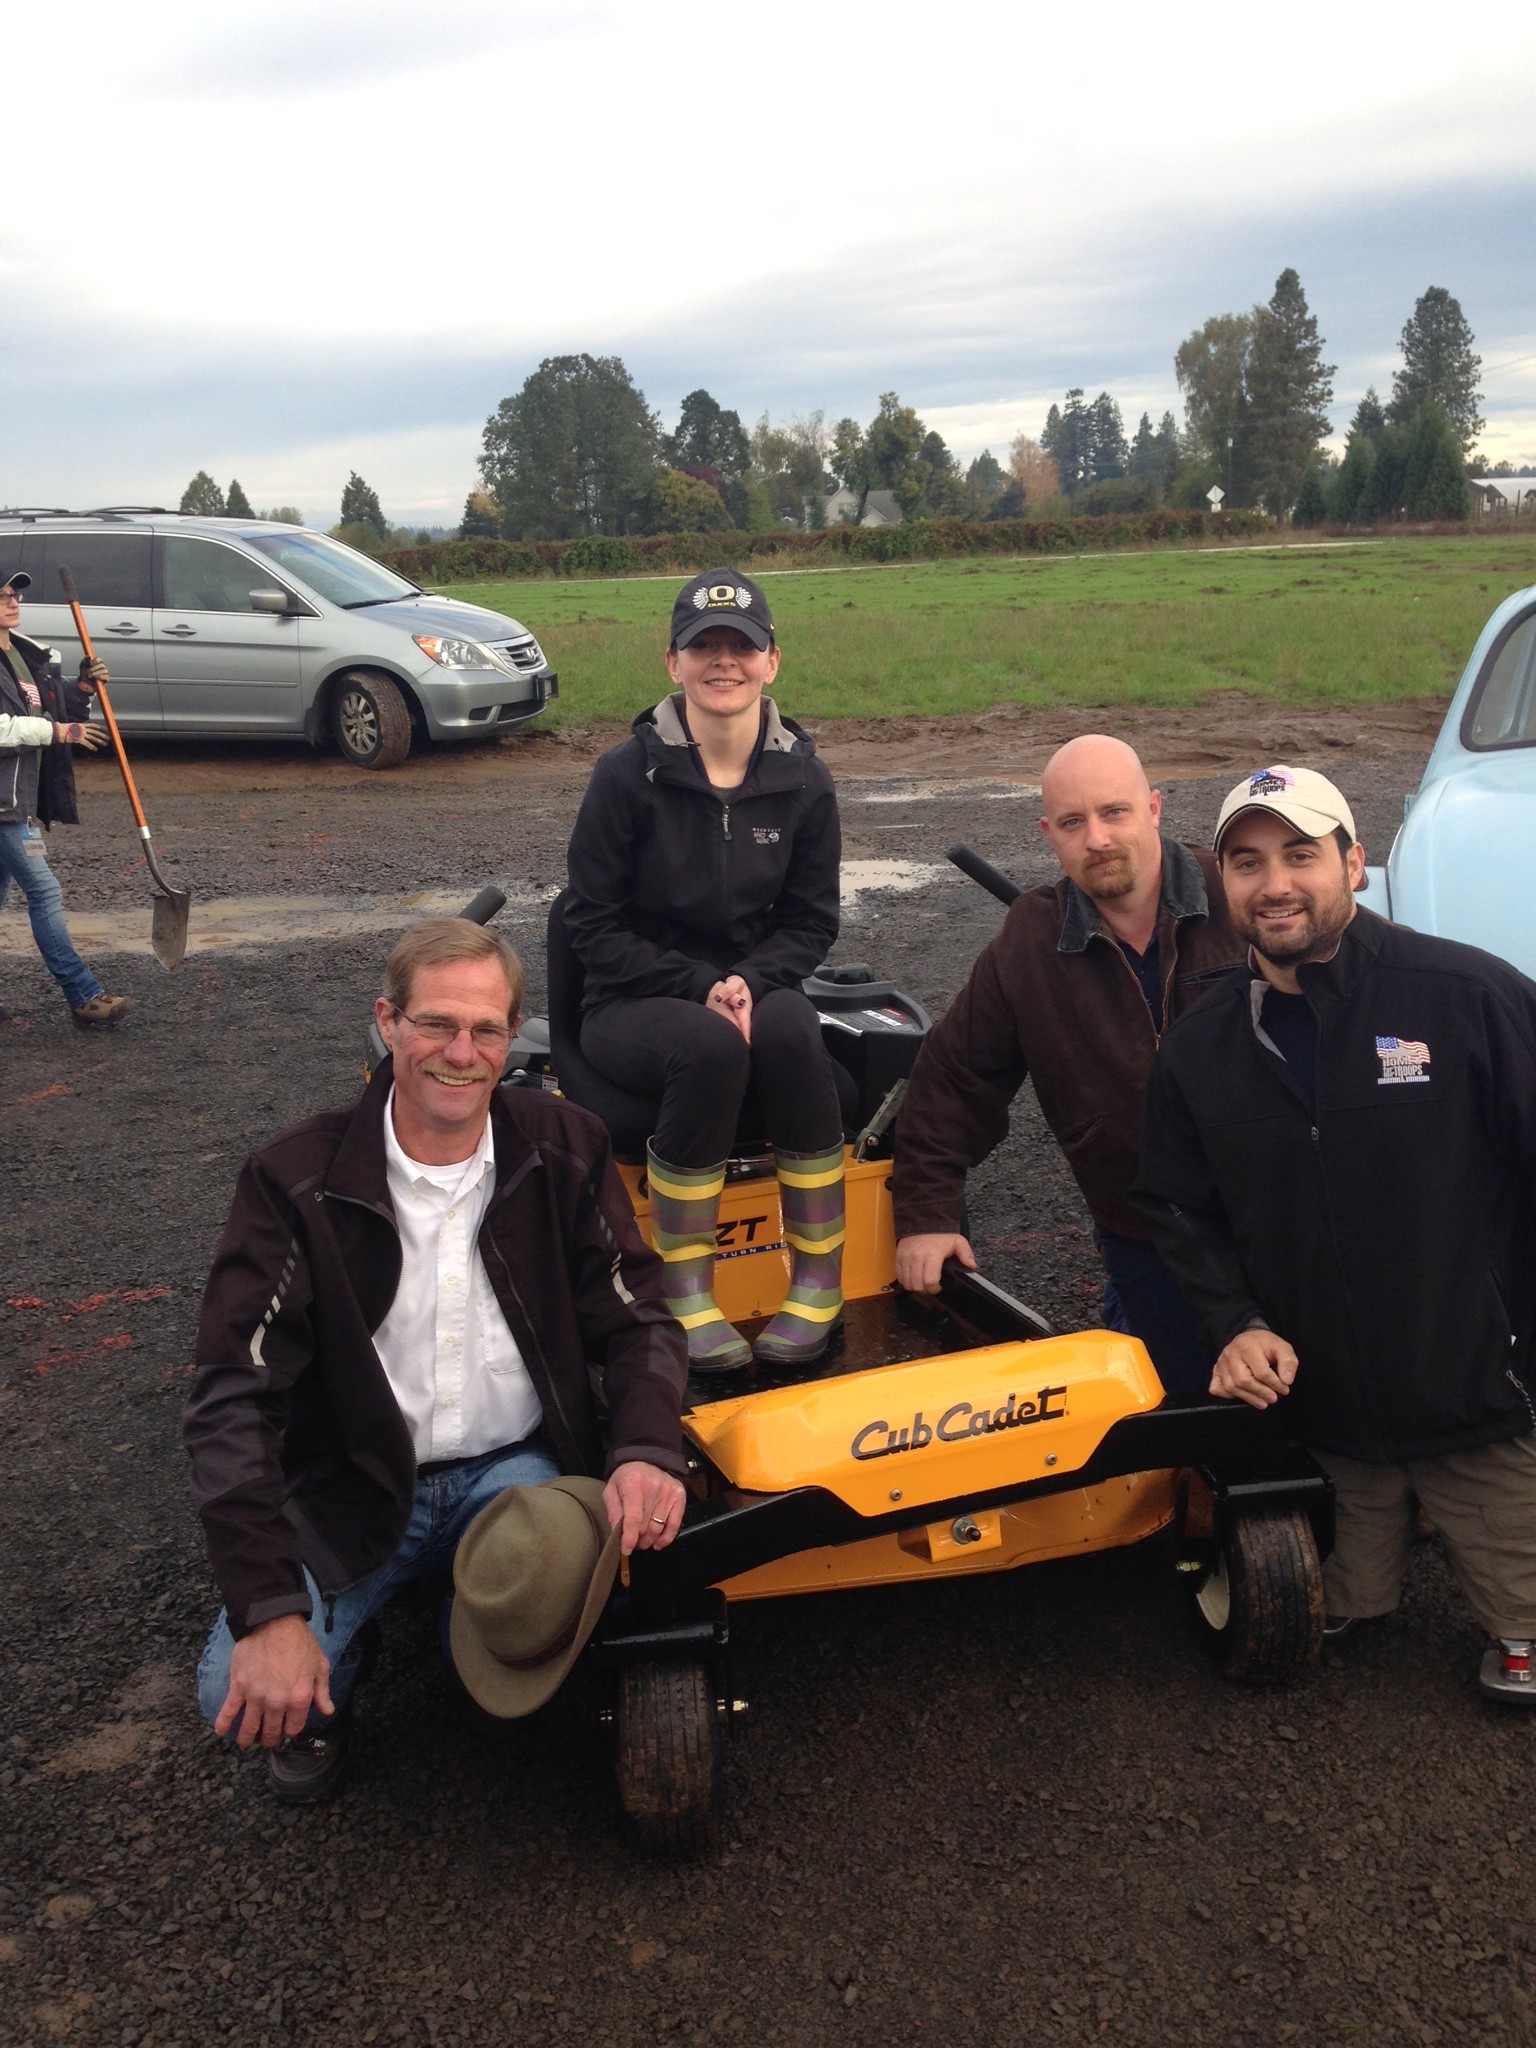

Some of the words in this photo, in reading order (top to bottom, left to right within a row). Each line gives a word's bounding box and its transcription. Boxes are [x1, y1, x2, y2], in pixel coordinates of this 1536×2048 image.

[709, 585, 735, 601] O
[1394, 1065, 1423, 1079] TROOPS
[851, 1412, 932, 1461] Cub
[936, 1386, 1068, 1442] Cadet
